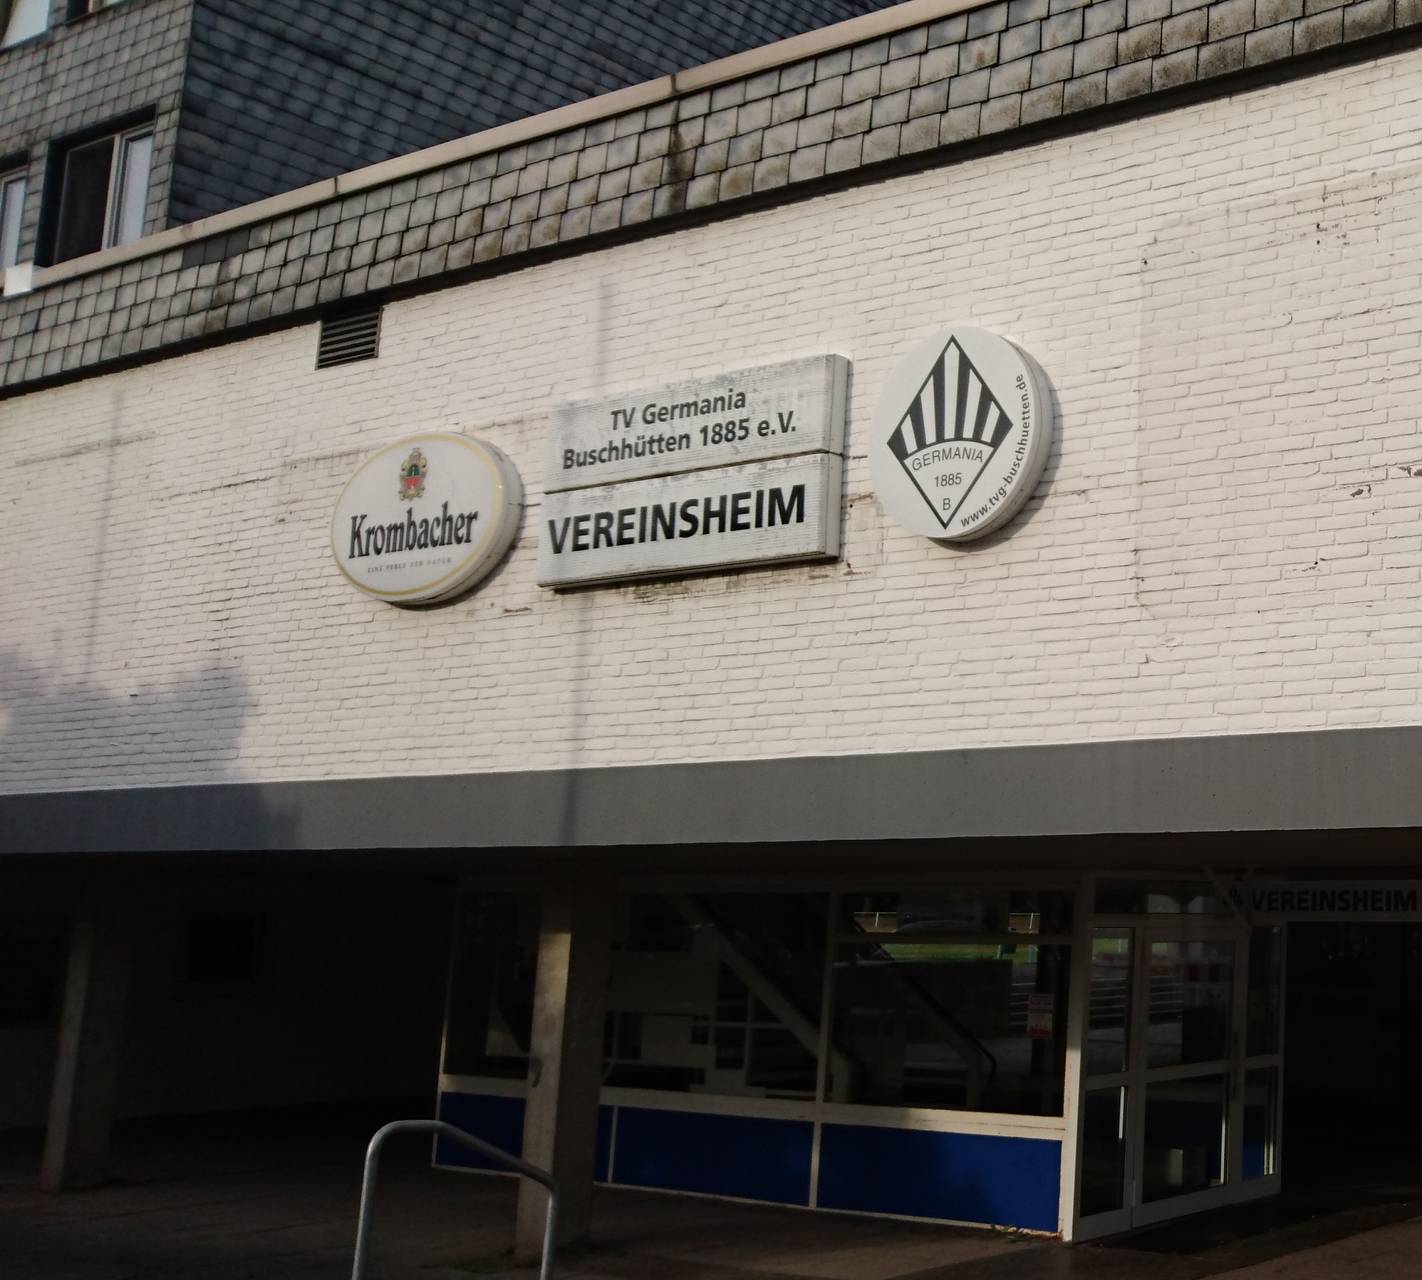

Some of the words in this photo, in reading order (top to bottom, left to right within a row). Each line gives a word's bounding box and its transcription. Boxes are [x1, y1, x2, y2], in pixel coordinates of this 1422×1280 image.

[611, 406, 636, 430] TV
[642, 388, 746, 425] Germania
[563, 432, 691, 470] Buschhütten
[699, 417, 750, 446] 1885
[757, 410, 797, 437] e.V.
[912, 447, 984, 471] GERMANIA
[961, 374, 1030, 527] www.tvg-buschhuetten.de
[934, 472, 962, 487] 1885
[548, 484, 806, 554] VEREINSHEIM
[942, 498, 951, 510] B
[348, 501, 478, 559] Krombacher
[1253, 889, 1417, 912] VEREINSHEIM
